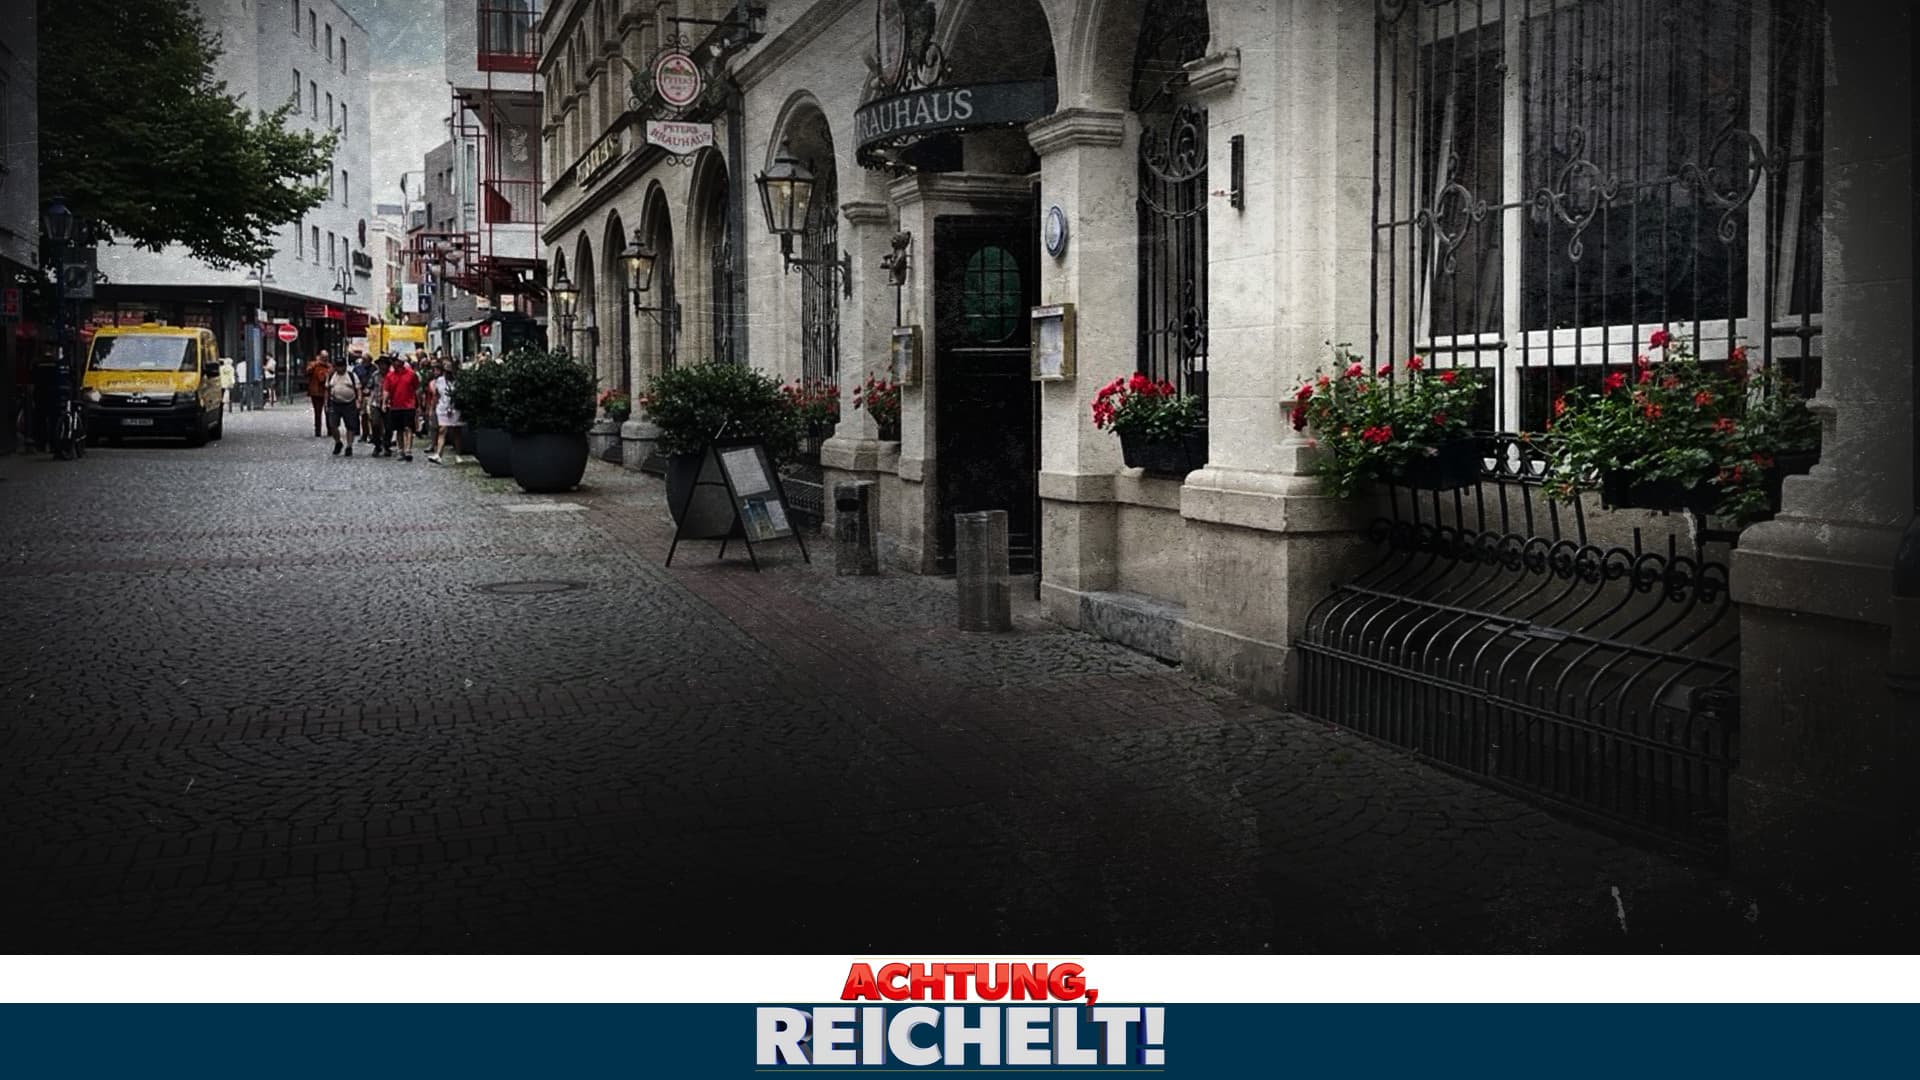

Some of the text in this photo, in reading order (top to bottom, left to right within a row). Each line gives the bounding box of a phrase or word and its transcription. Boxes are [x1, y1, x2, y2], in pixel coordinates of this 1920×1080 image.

[856, 89, 974, 144] RAUHAUS
[650, 127, 711, 147] BRAUHAUS
[663, 124, 698, 134] PETERS
